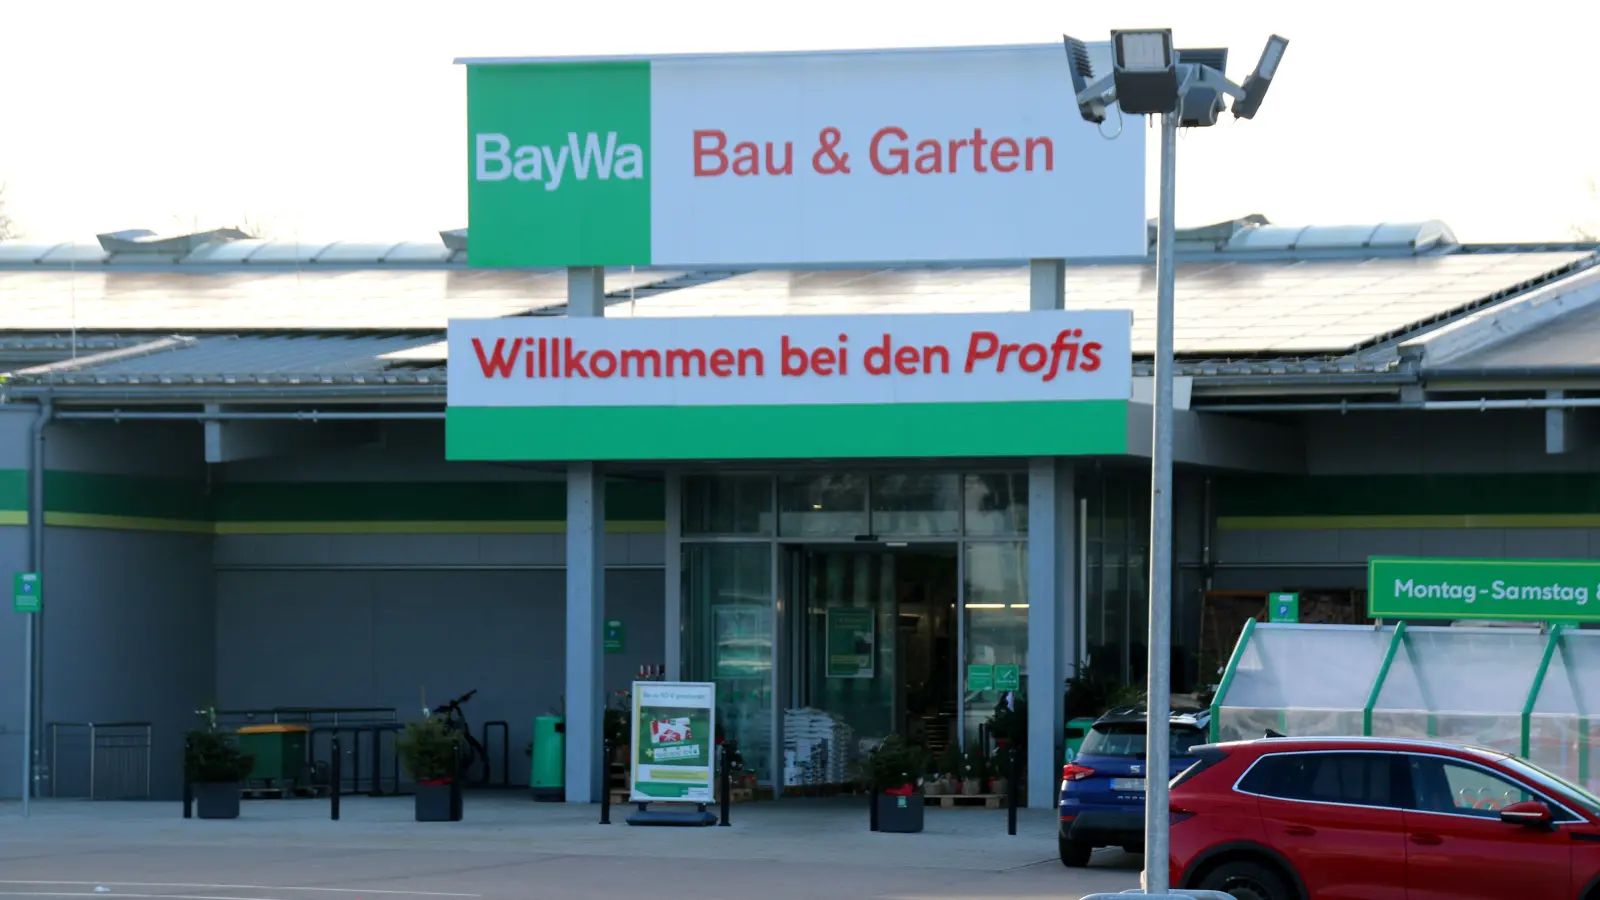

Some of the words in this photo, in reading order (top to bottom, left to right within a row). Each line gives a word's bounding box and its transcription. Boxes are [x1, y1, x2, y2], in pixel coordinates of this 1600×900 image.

[475, 131, 643, 192] BayWa
[693, 129, 793, 177] Bau
[812, 127, 851, 175] &
[869, 126, 1054, 174] Garten
[471, 336, 765, 379] Willkommen
[780, 333, 848, 376] bei
[863, 333, 951, 375] den
[964, 327, 1103, 382] Profis
[1394, 578, 1588, 605] Montag-Samstag
